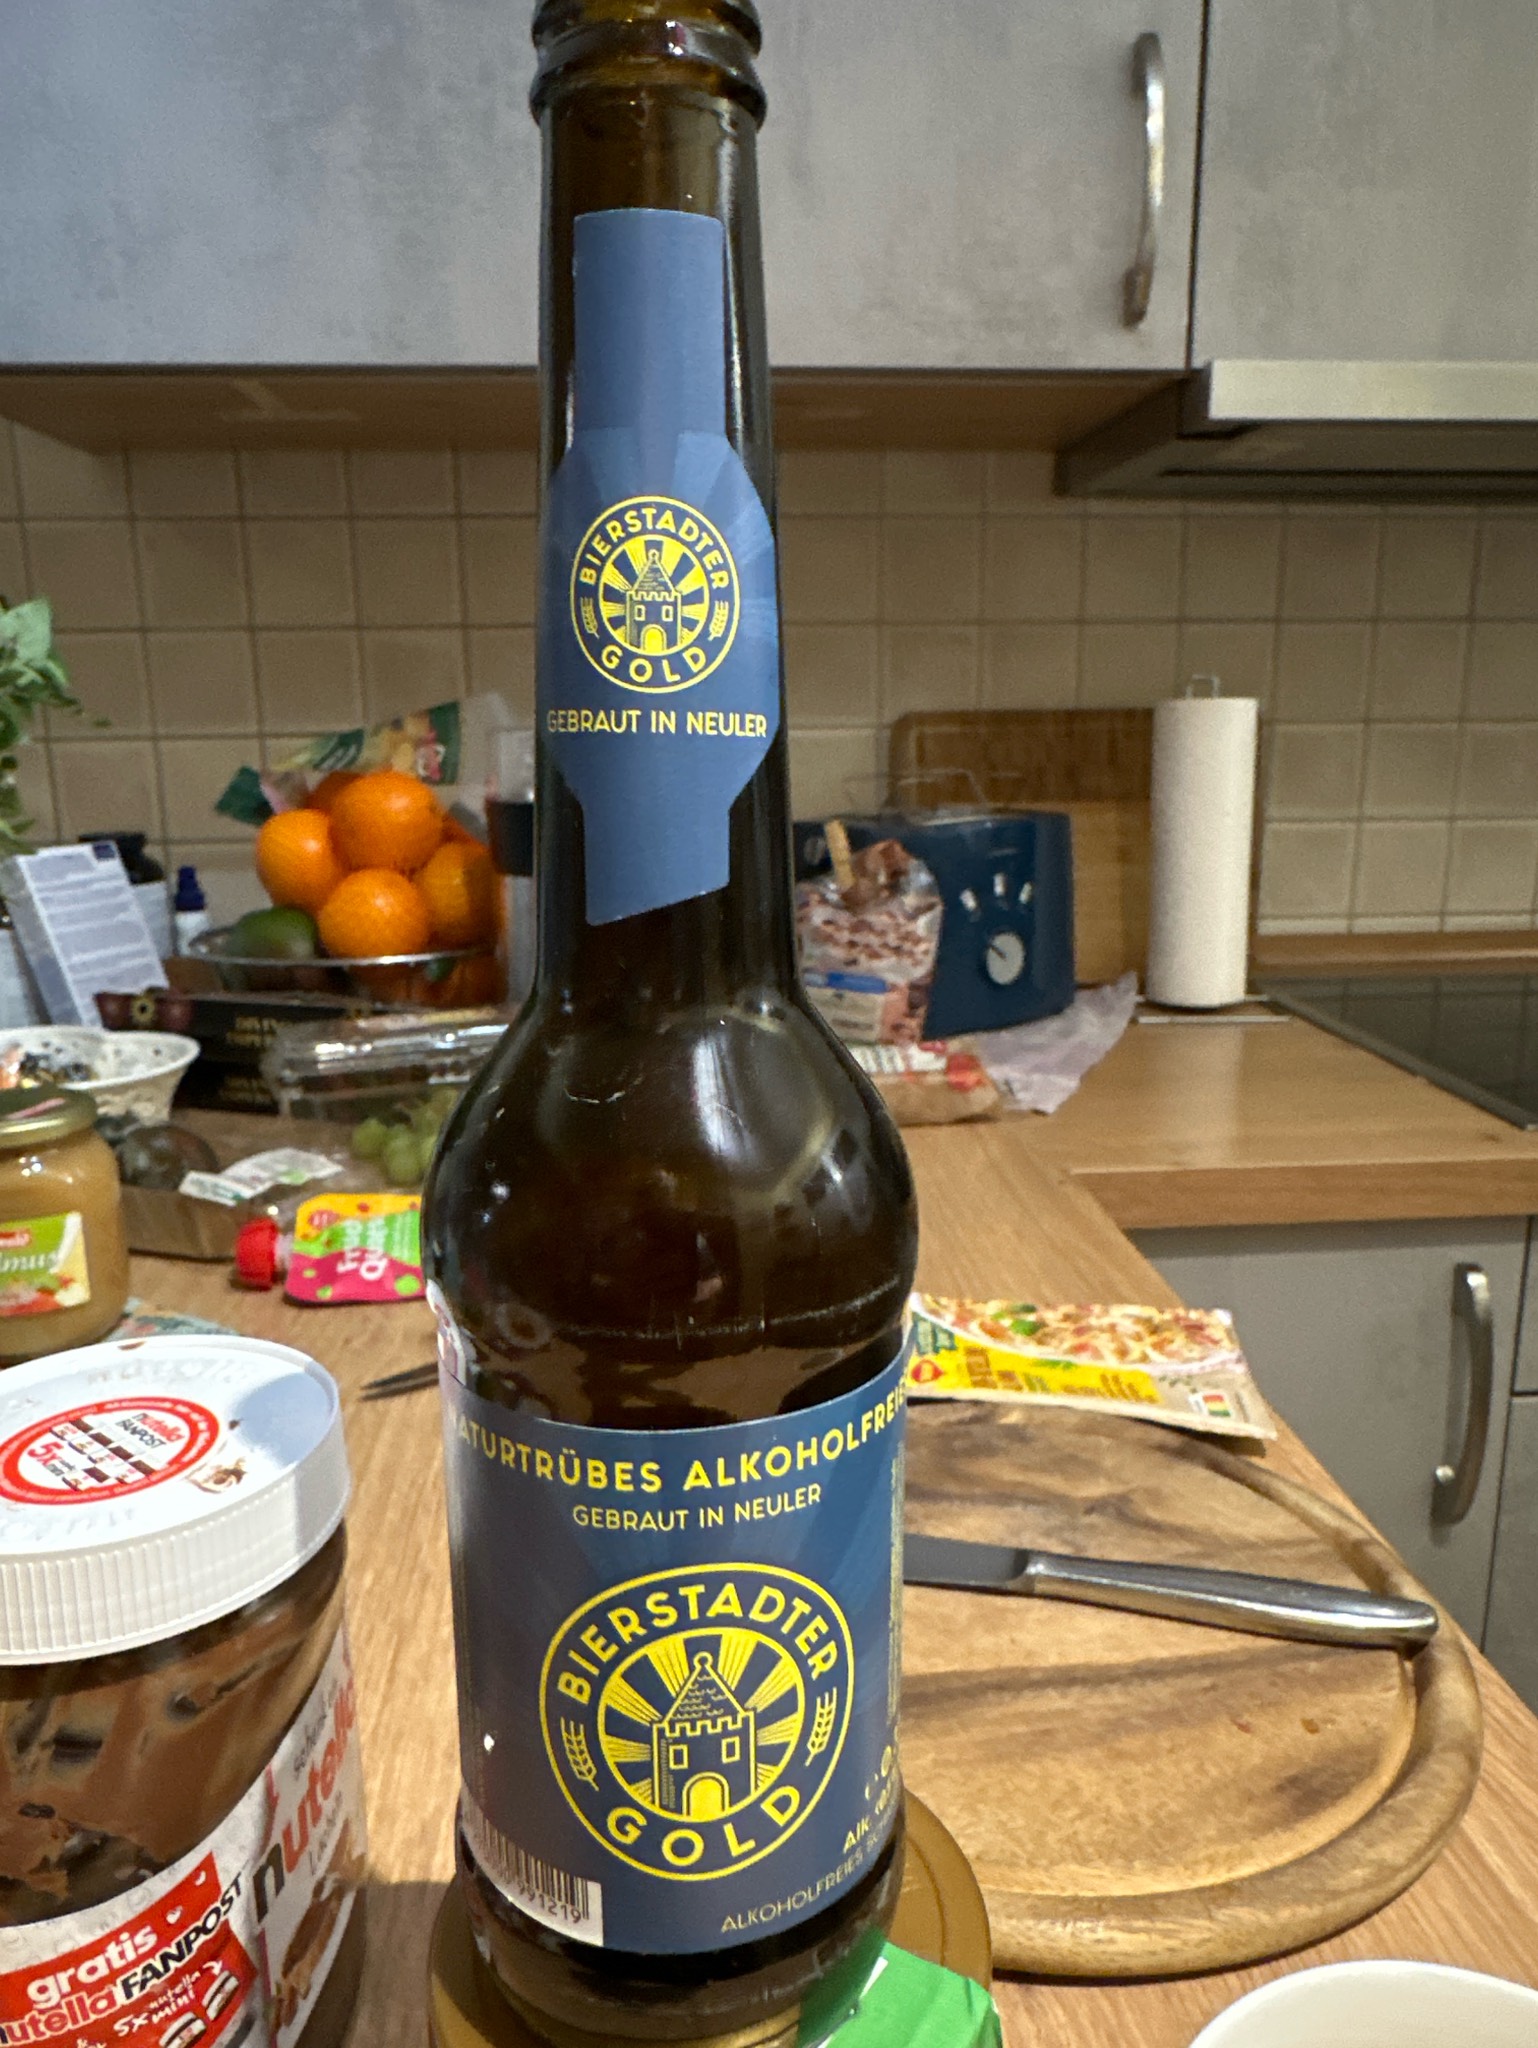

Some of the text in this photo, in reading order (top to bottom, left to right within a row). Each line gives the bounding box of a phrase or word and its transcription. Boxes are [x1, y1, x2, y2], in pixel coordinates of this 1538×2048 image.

[580, 507, 730, 590] BIERSTADTER
[601, 644, 707, 683] GOLD
[547, 710, 767, 738] GEBRAUT IN NEULER
[572, 1483, 822, 1532] GEBRAUT IN NEULER
[557, 1582, 838, 1705] BIERSTADTER
[606, 1785, 801, 1867] GOLD
[26, 1924, 159, 2009] gratis
[119, 1871, 242, 2001] FANPOST
